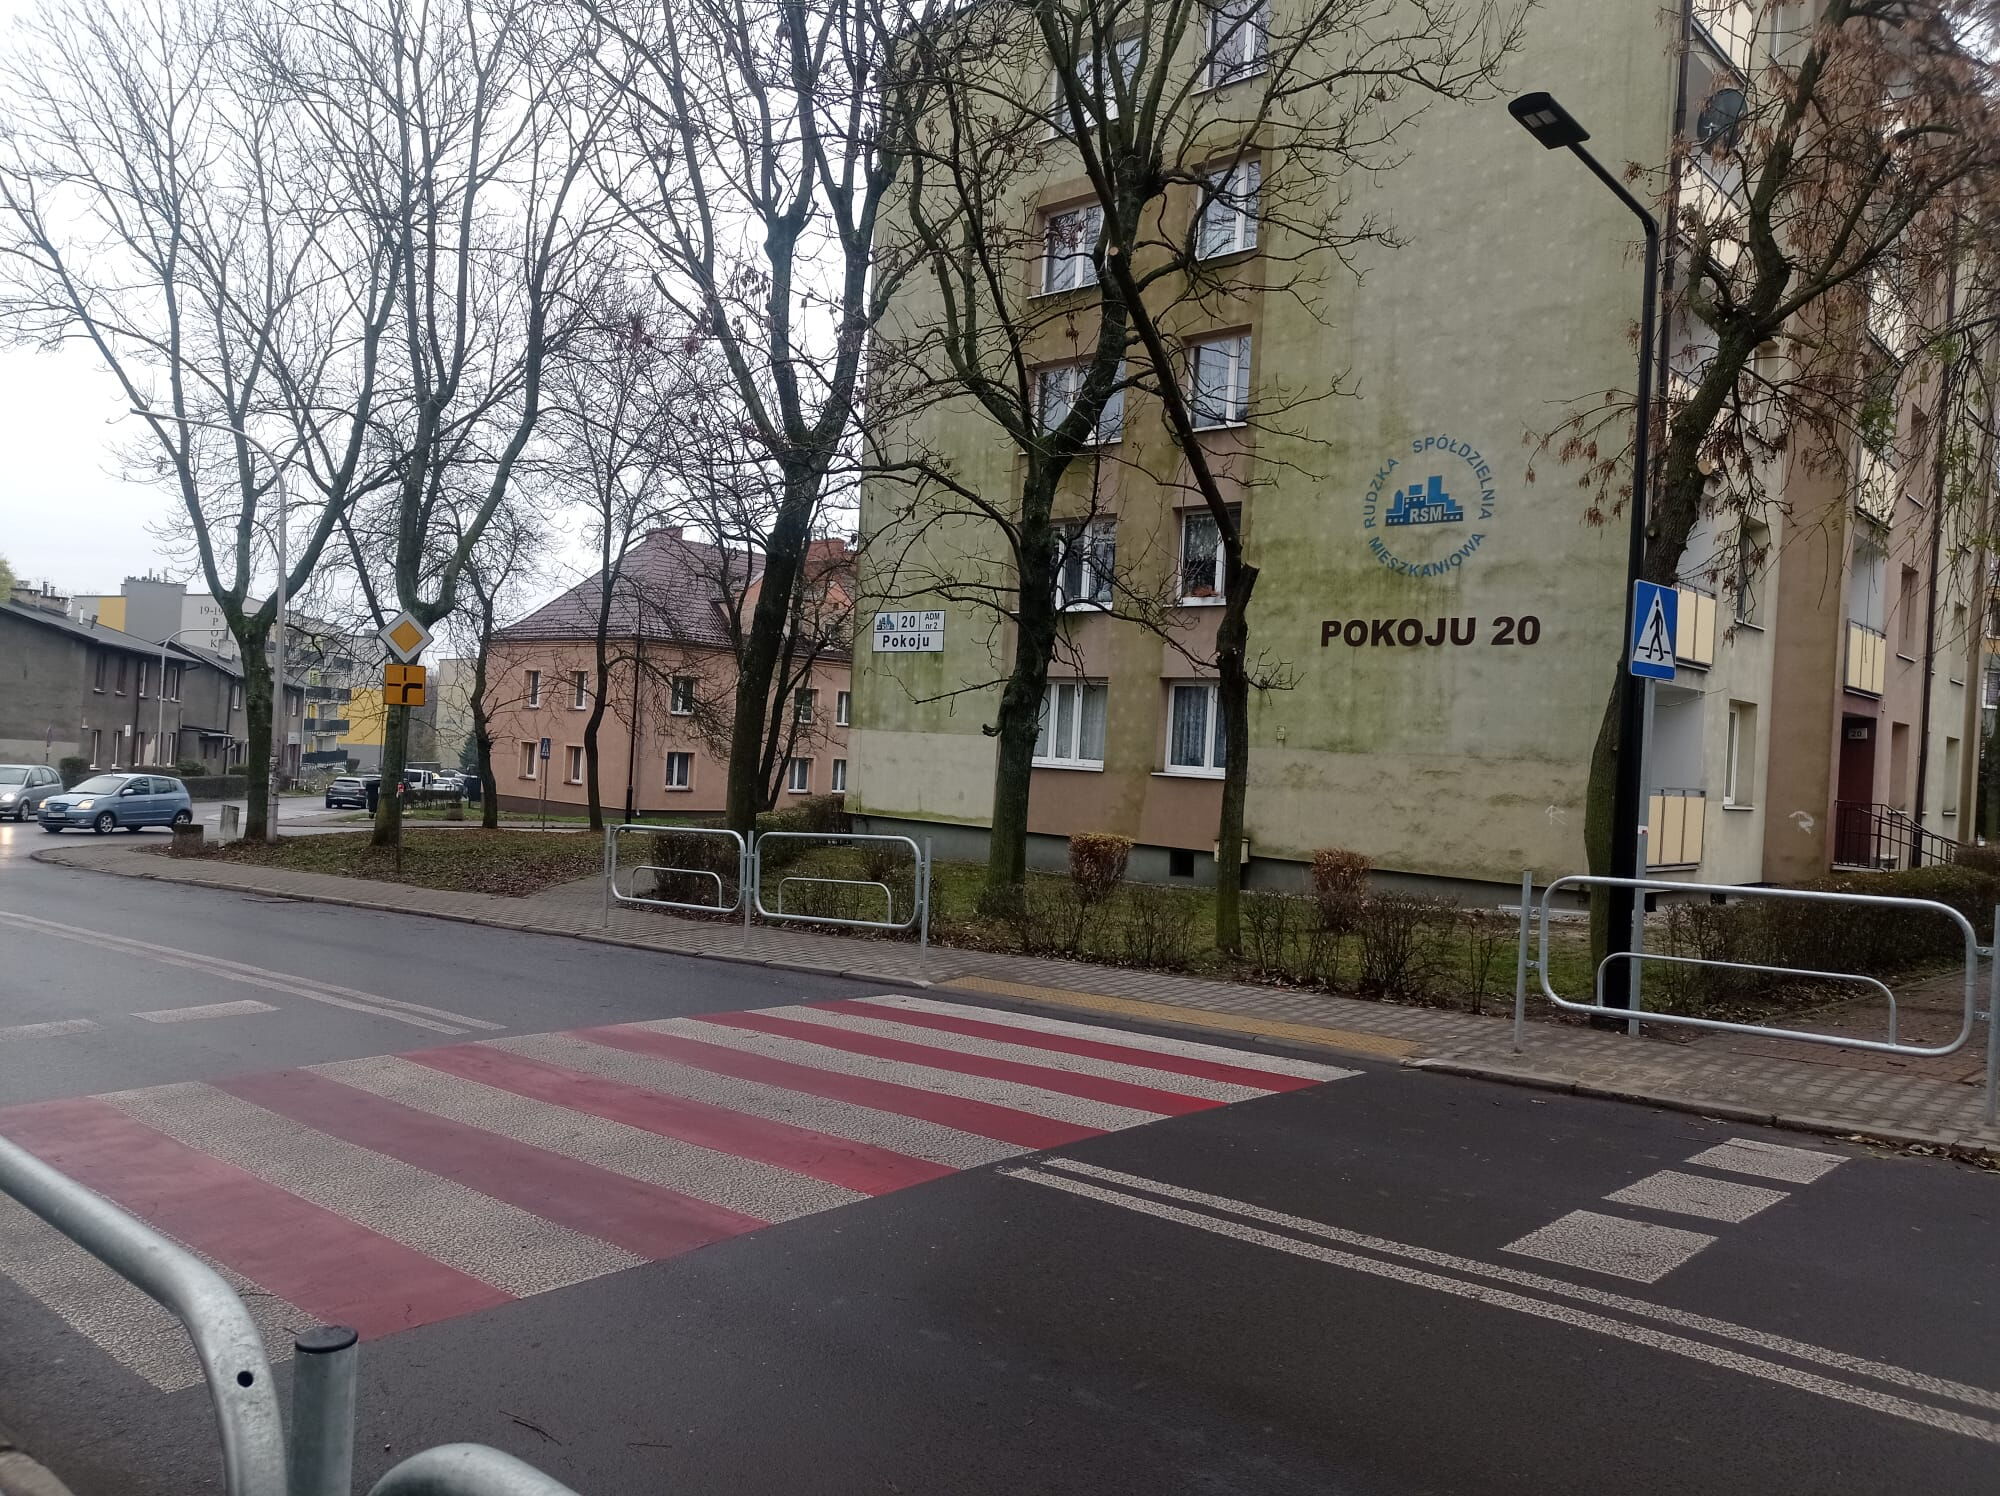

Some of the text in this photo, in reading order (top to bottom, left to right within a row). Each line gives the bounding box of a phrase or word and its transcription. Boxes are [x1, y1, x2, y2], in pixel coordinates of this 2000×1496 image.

[1364, 434, 1496, 577] RUDZKA SPÓŁDZIELNIA MIESZKANIOWA
[1409, 506, 1442, 523] RSM
[901, 615, 915, 628] 20
[924, 612, 940, 620] ADM
[1320, 615, 1541, 648] POKOJU 20
[882, 633, 930, 650] Pokoju
